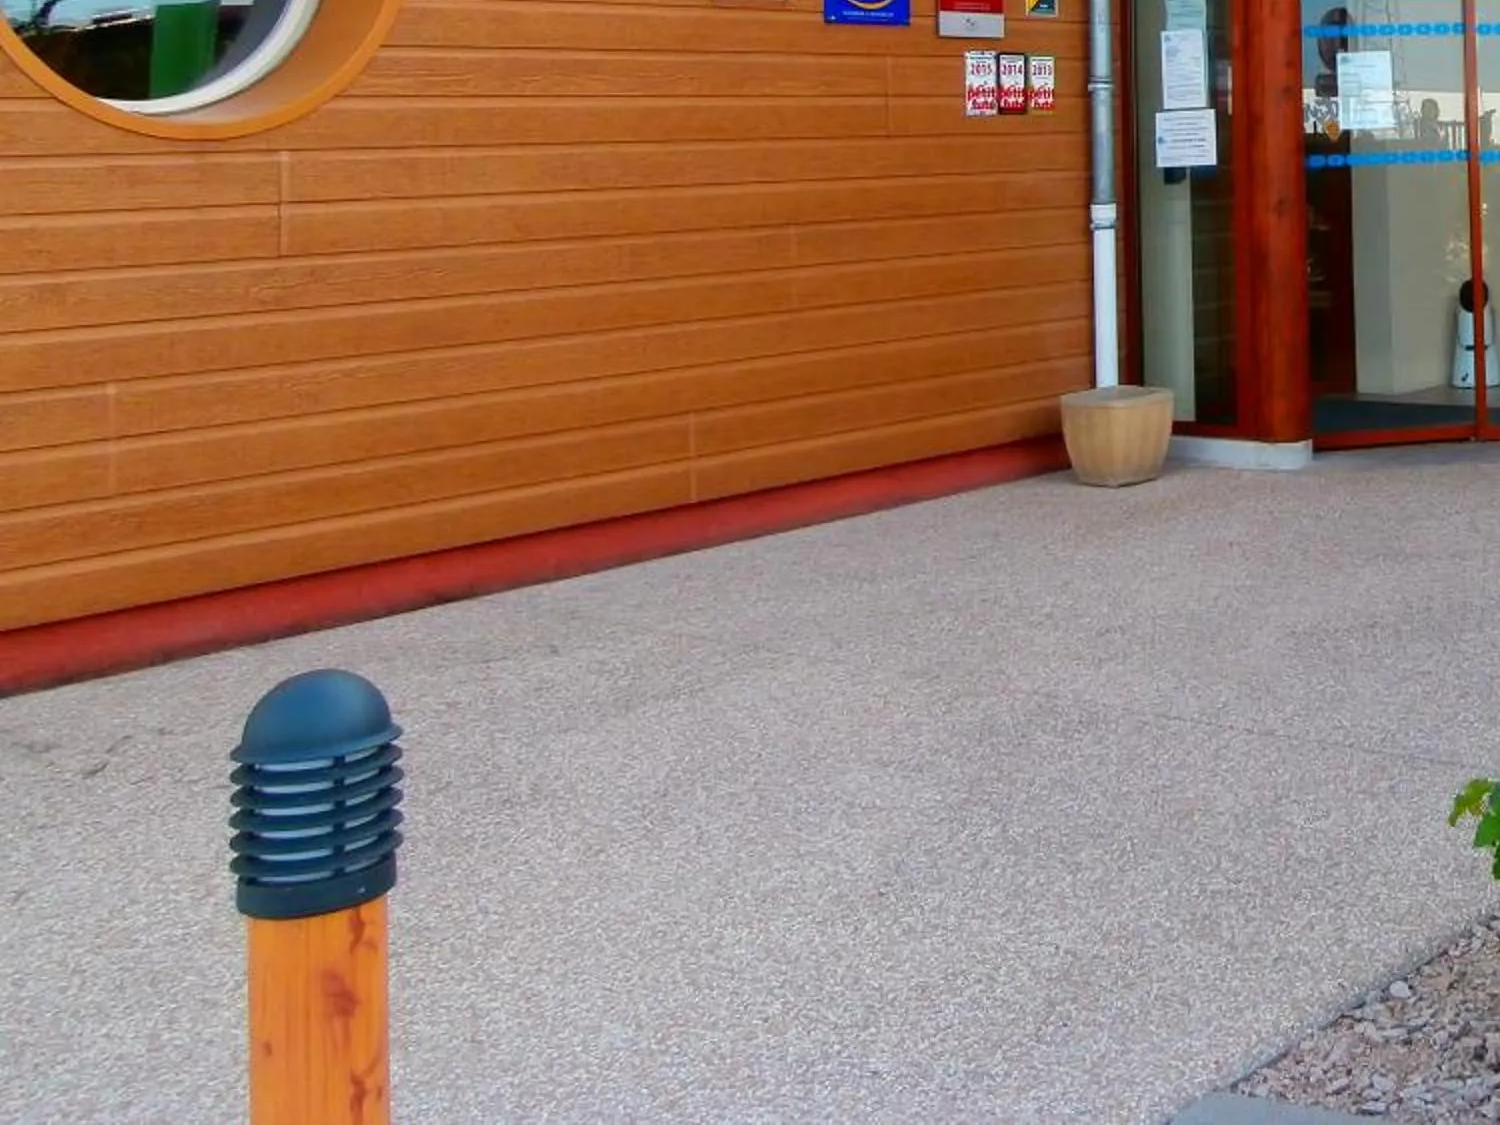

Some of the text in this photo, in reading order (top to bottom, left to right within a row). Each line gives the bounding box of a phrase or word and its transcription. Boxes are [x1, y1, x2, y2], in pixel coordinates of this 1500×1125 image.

[971, 63, 993, 76] 2015
[1001, 63, 1023, 76] 2014
[1032, 63, 1052, 76] 2013
